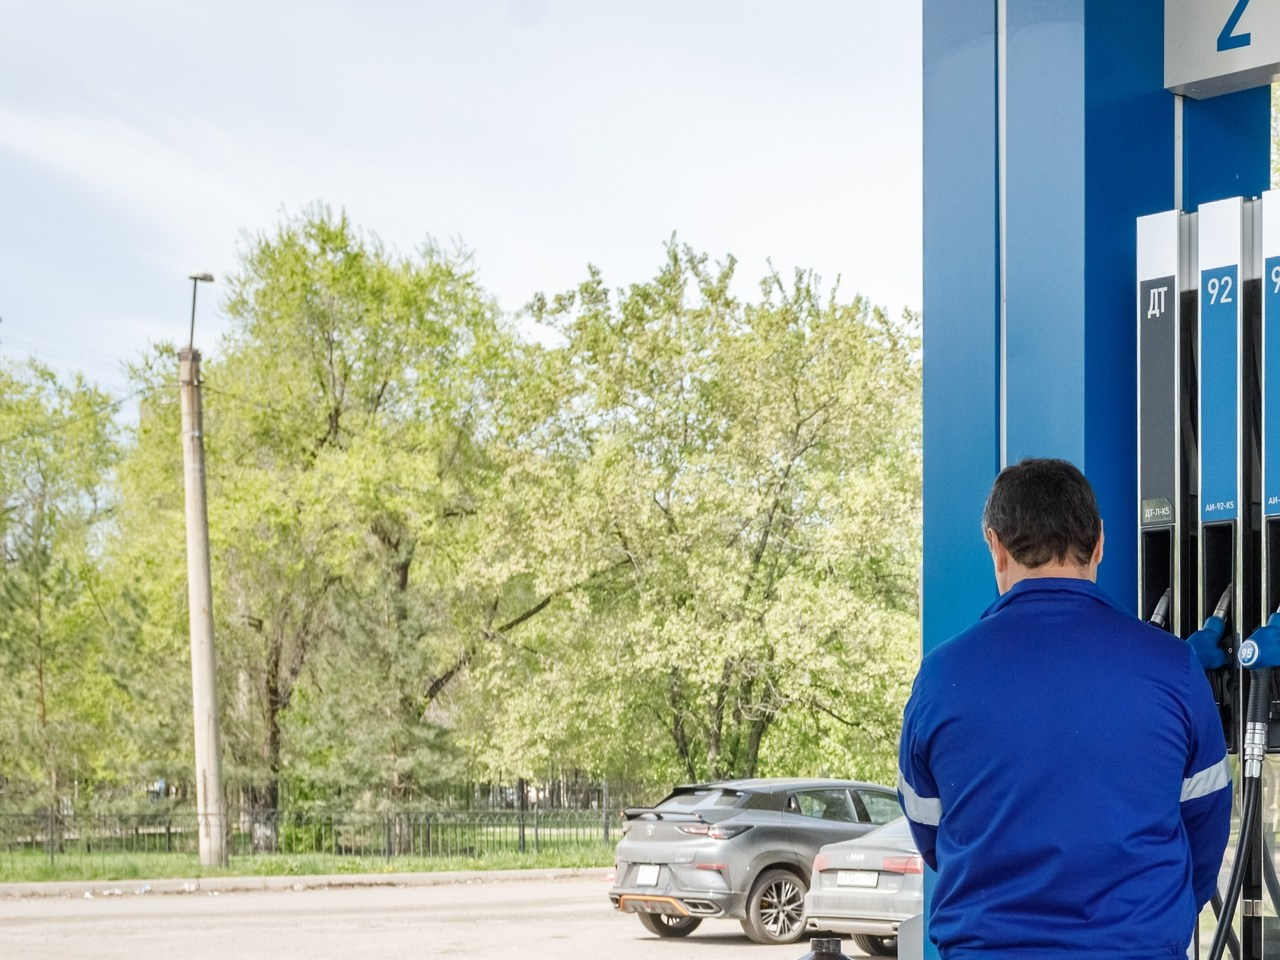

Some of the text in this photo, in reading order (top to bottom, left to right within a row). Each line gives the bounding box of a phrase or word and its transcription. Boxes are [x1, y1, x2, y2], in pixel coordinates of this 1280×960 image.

[1207, 276, 1233, 305] 92
[1147, 286, 1168, 319] ДТ
[1205, 501, 1235, 512] АИ-92-К5
[1144, 507, 1170, 519] ДТ-Л-К5
[1241, 648, 1253, 659] 95
